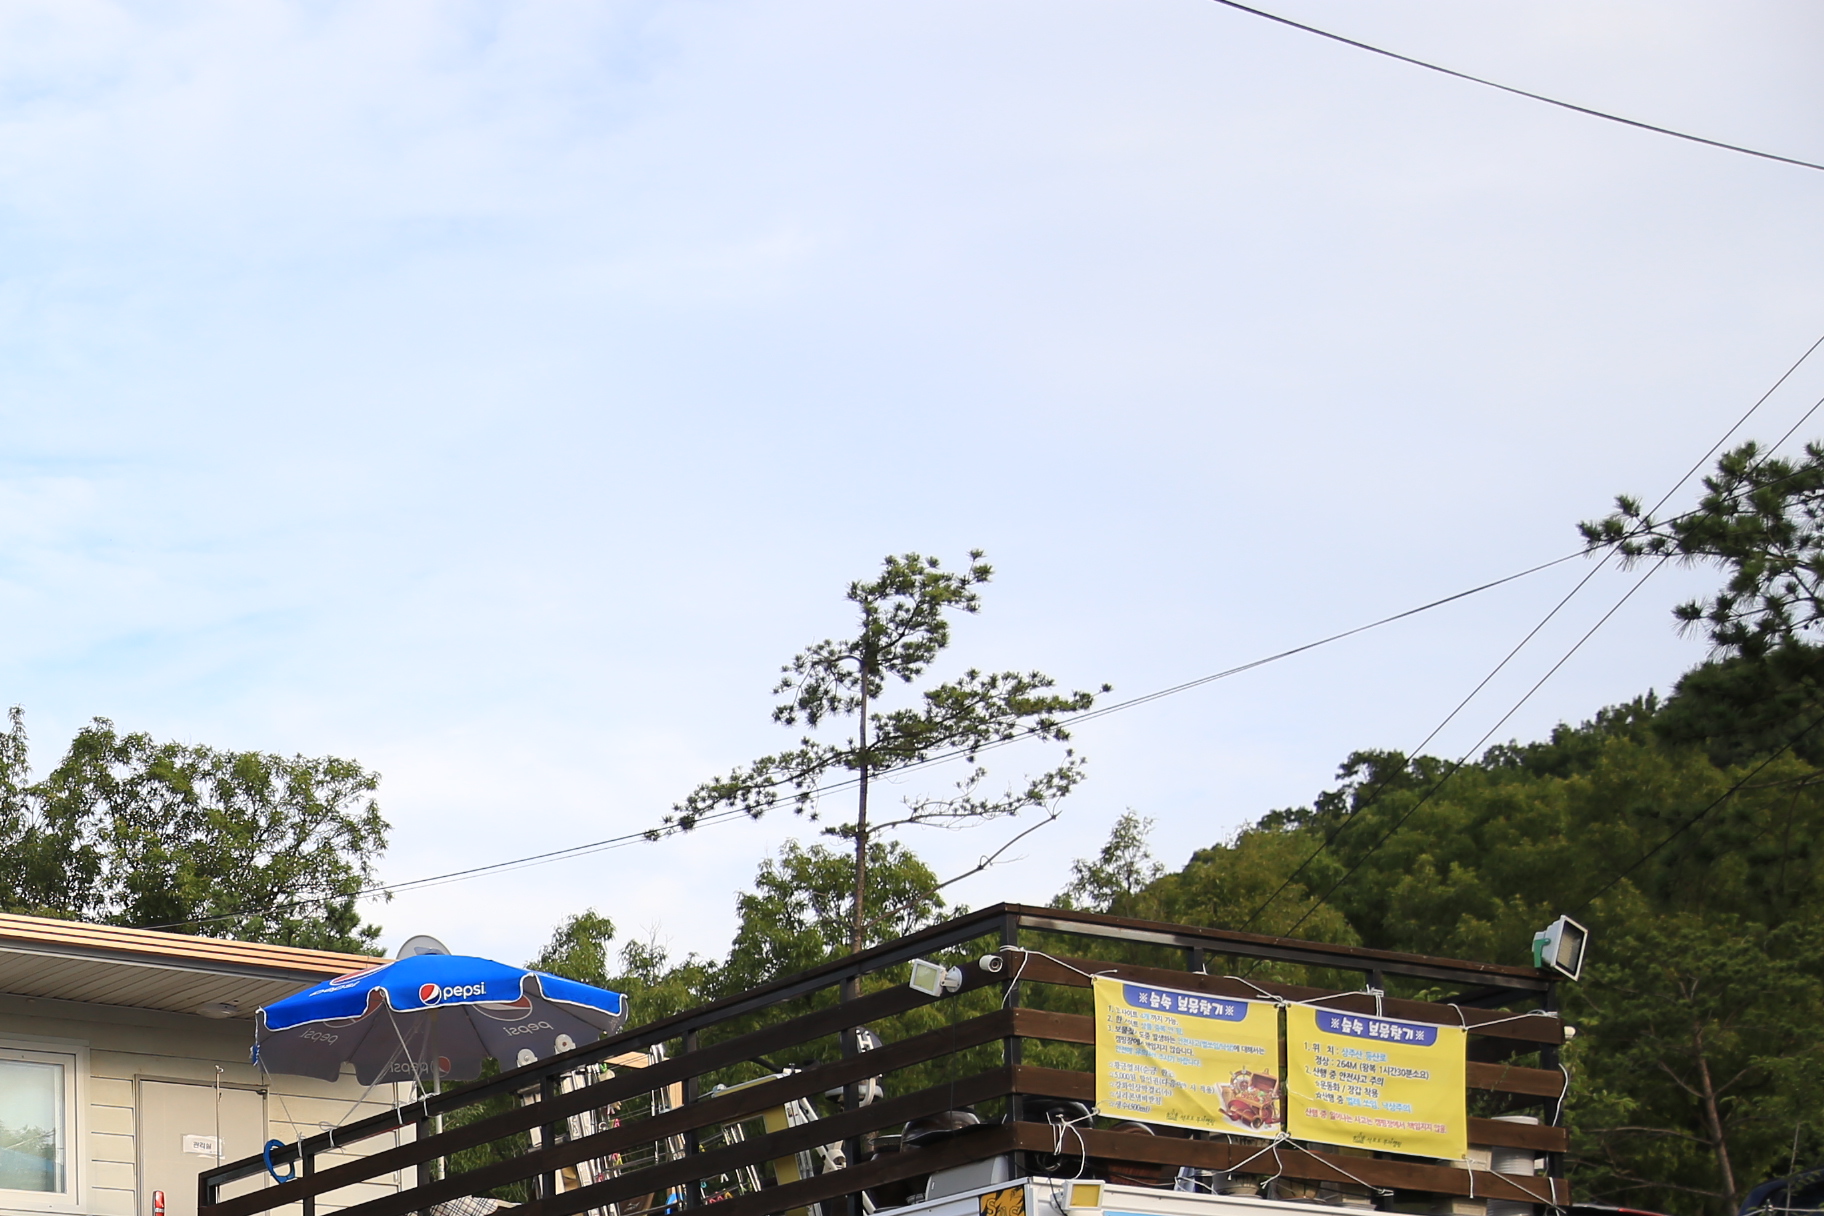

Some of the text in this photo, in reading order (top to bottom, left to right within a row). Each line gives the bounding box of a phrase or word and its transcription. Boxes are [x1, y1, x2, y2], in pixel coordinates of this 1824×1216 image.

[443, 982, 486, 1000] pepsi
[1315, 1055, 1329, 1066] 정상
[1337, 1059, 1357, 1070] 264M
[1360, 1062, 1376, 1073] (왕복
[1313, 1067, 1327, 1078] 산행
[1330, 1070, 1336, 1079] 중
[1340, 1071, 1367, 1083] 안전사고
[1369, 1077, 1384, 1087] 주의
[193, 1141, 212, 1150] 관리실
